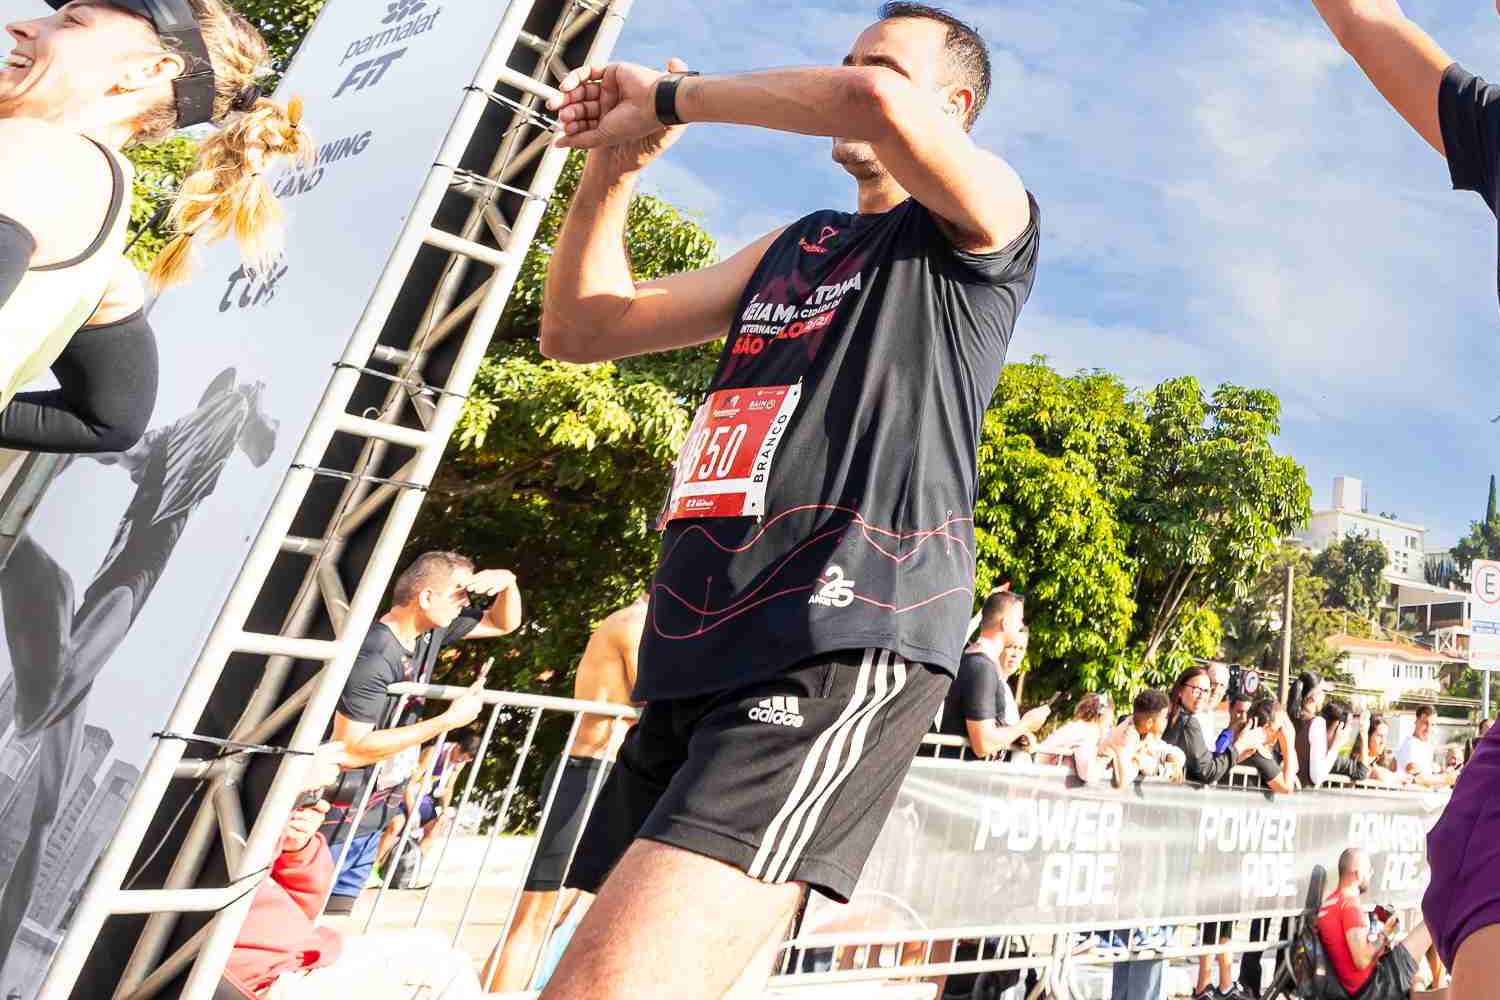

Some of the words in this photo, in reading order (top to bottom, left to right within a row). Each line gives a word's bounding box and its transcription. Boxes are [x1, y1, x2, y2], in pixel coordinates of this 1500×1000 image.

[339, 6, 442, 65] parmalat
[751, 414, 788, 484] BRANCO
[1485, 572, 1496, 595] E
[748, 707, 804, 728] adidas
[974, 798, 1124, 852] POWER
[1198, 806, 1297, 853] POWER
[1037, 853, 1120, 907] ADE
[1241, 852, 1297, 899] ADE
